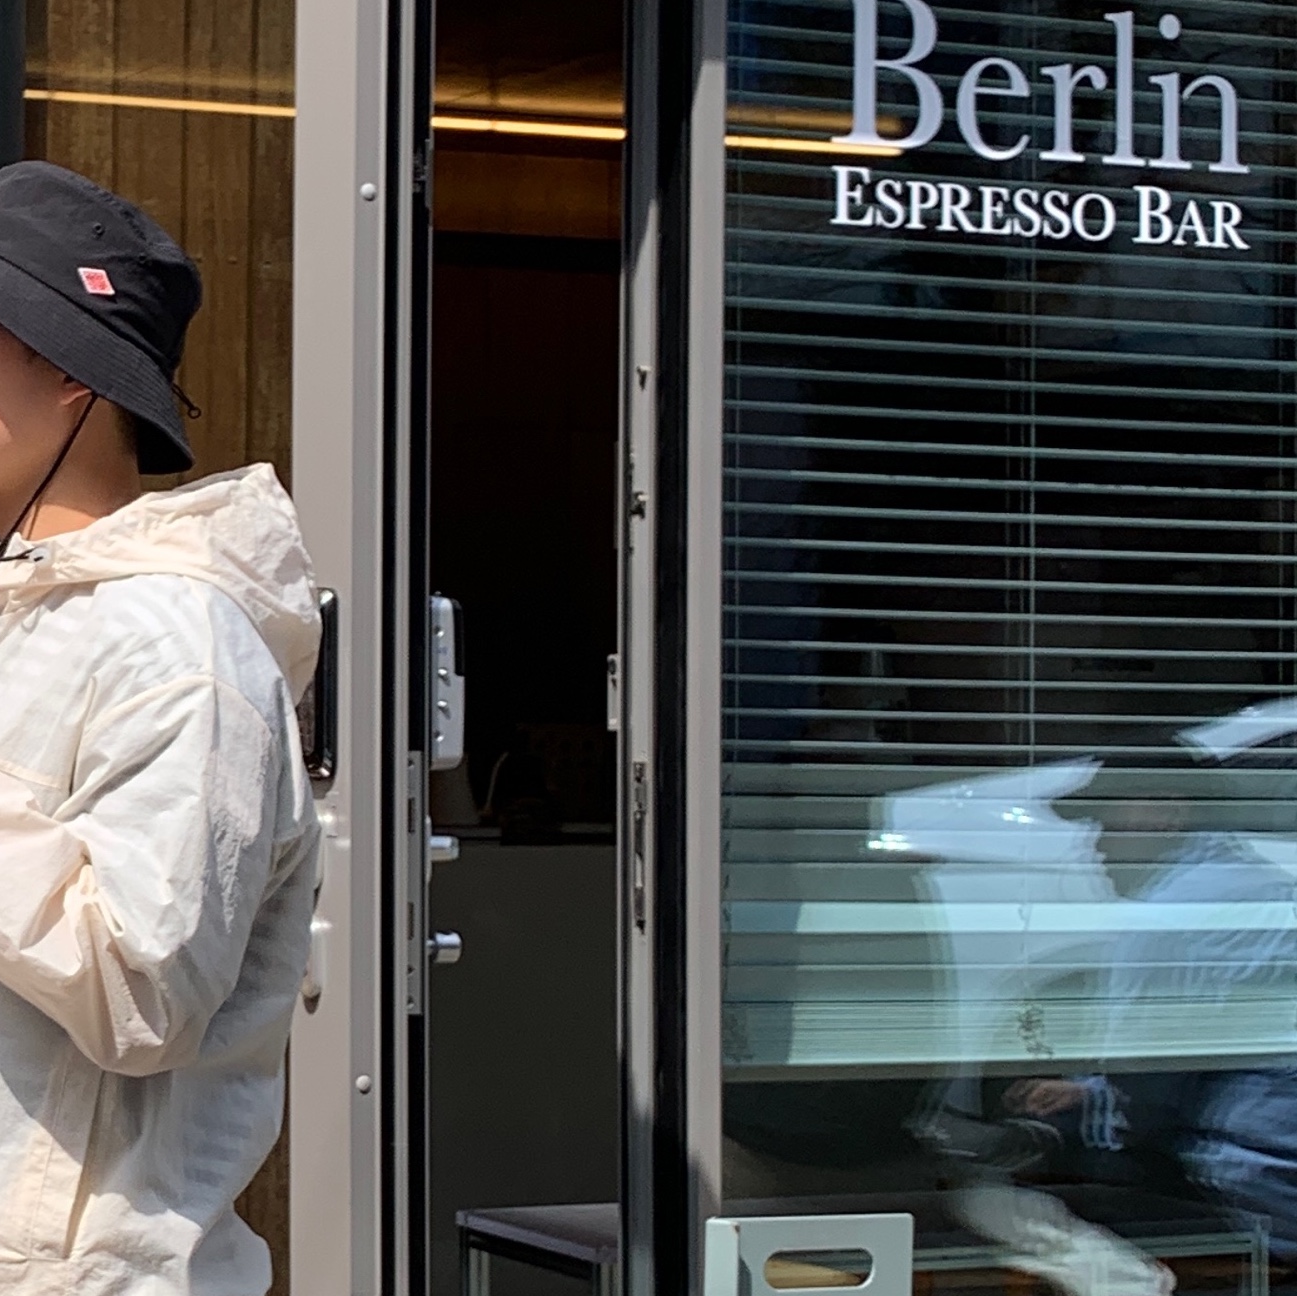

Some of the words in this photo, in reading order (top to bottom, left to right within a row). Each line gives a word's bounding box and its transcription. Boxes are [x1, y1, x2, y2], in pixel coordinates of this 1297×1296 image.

[831, 0, 1250, 174] Berlin
[830, 166, 1116, 242] ESPRESSO
[1131, 185, 1251, 250] BAR
